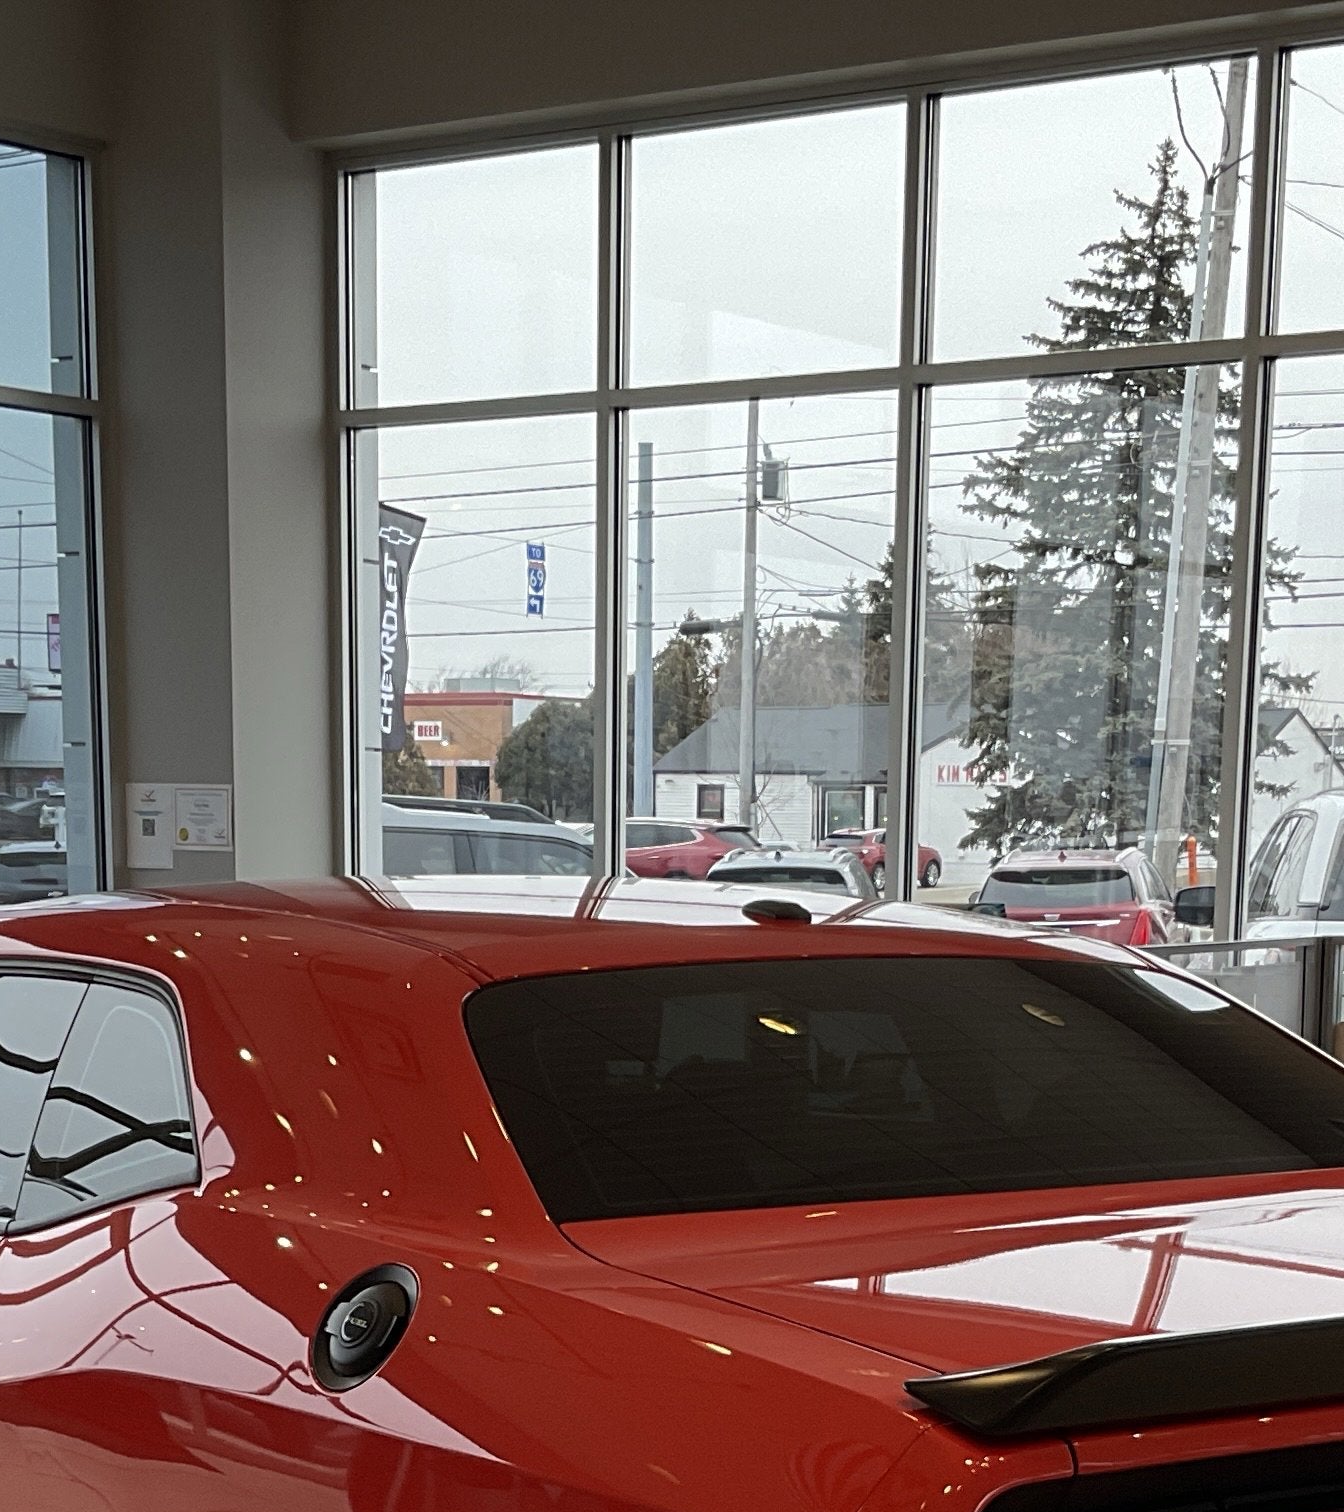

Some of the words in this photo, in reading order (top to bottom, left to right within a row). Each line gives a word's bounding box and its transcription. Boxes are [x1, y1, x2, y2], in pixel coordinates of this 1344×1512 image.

[530, 547, 542, 559] TO
[530, 569, 544, 588] 69
[379, 552, 399, 734] CHEVROLET
[417, 725, 440, 737] BEER
